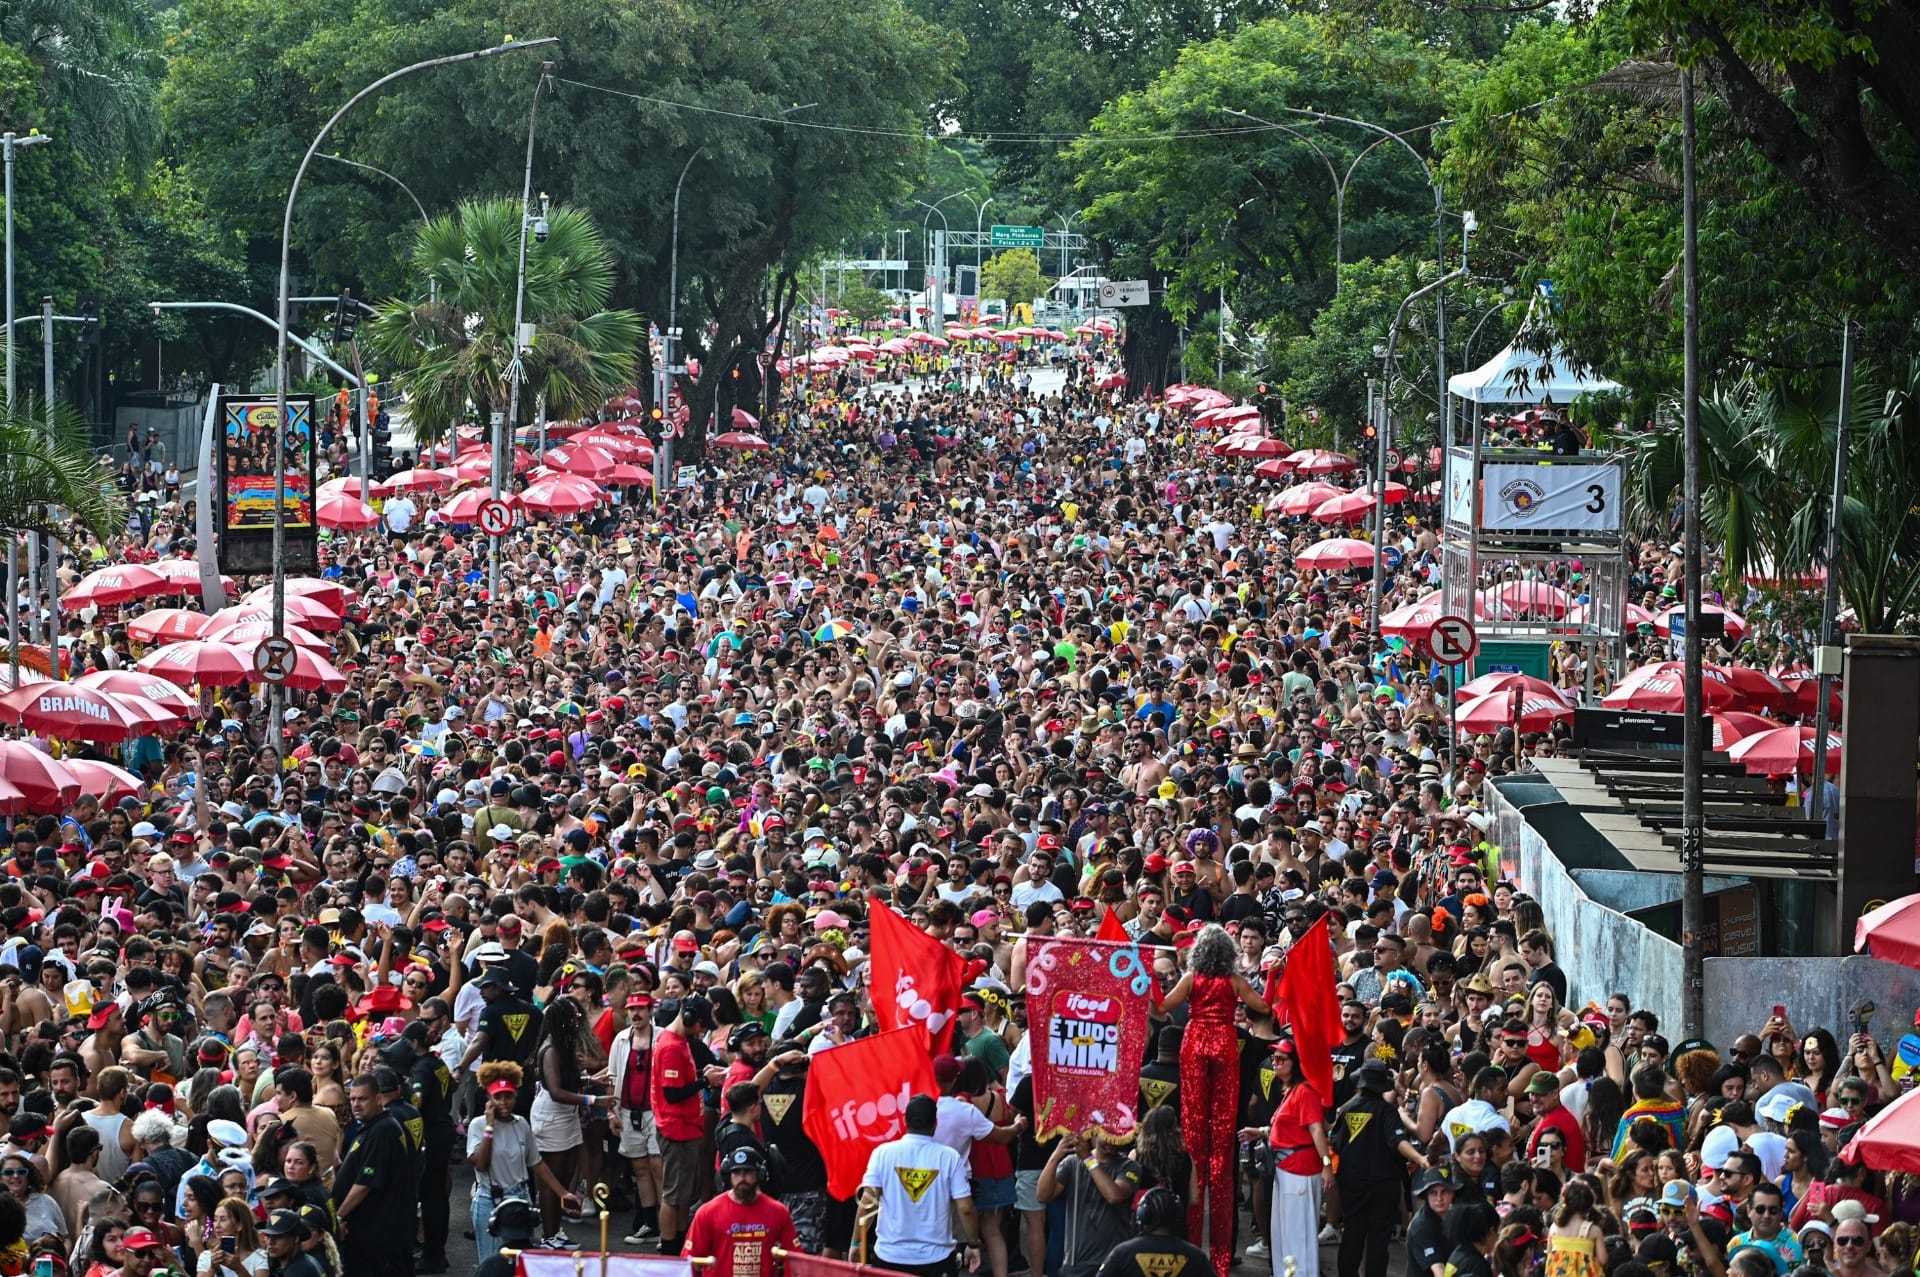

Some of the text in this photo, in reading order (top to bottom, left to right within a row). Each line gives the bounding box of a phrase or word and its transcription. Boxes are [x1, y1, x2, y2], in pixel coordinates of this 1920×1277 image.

[588, 436, 620, 449] BRAHMA
[1586, 484, 1604, 513] 3
[1443, 627, 1460, 654] E
[40, 696, 110, 721] BRAHMA
[1066, 994, 1110, 1012] ifood
[1050, 1013, 1118, 1042] É TUDO
[1049, 1038, 1117, 1072] MIM
[1069, 1068, 1105, 1076] CARNAVAL
[831, 1082, 910, 1140] ifood
[733, 1246, 762, 1255] ALCEU
